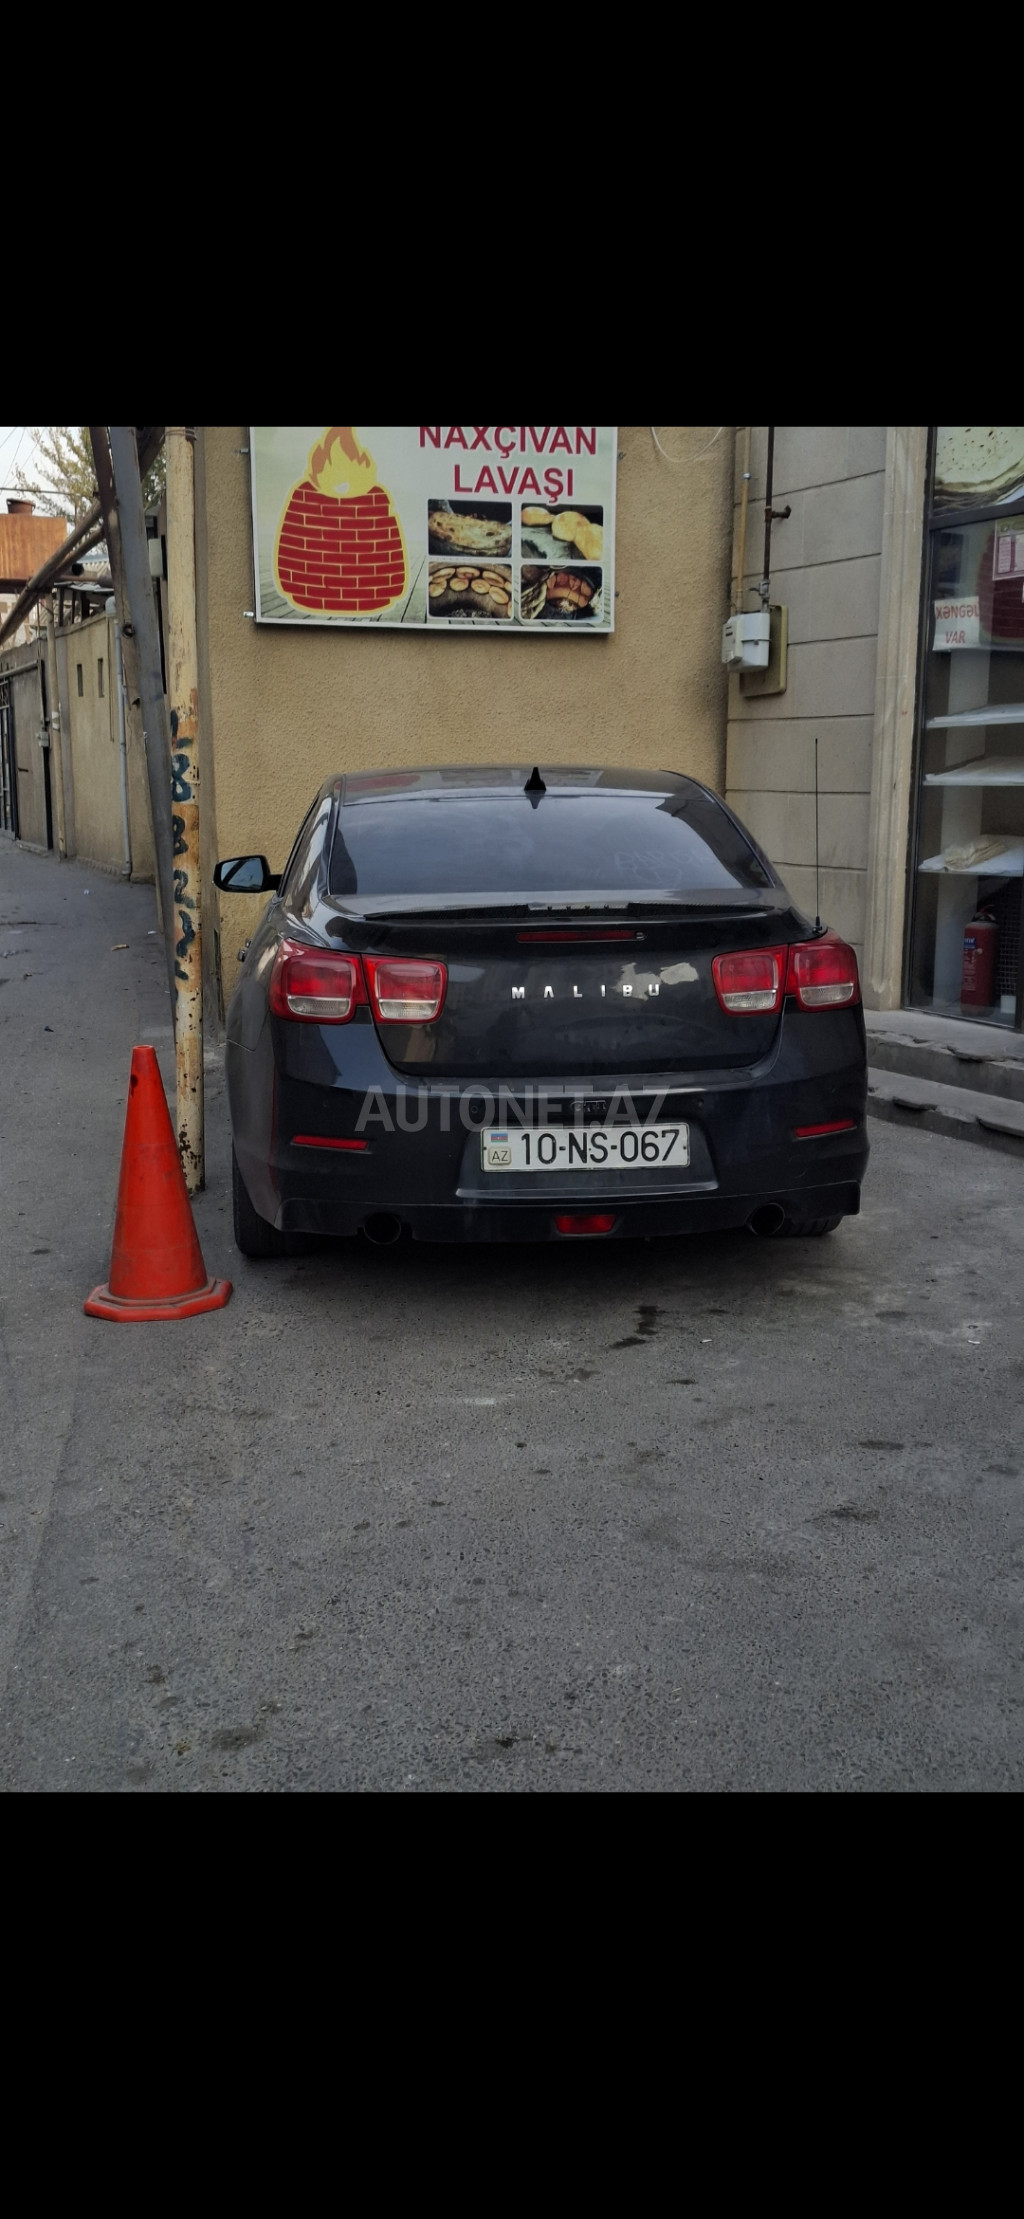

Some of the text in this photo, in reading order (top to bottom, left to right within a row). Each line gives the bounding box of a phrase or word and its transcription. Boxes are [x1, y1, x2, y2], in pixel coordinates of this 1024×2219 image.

[419, 427, 597, 458] NAXÇIVAN
[454, 464, 573, 503] LAVAŞI
[945, 630, 966, 644] VAR
[511, 984, 660, 999] MALIBU
[491, 1150, 509, 1163] AZ
[520, 1129, 680, 1166] 10-NS-067
